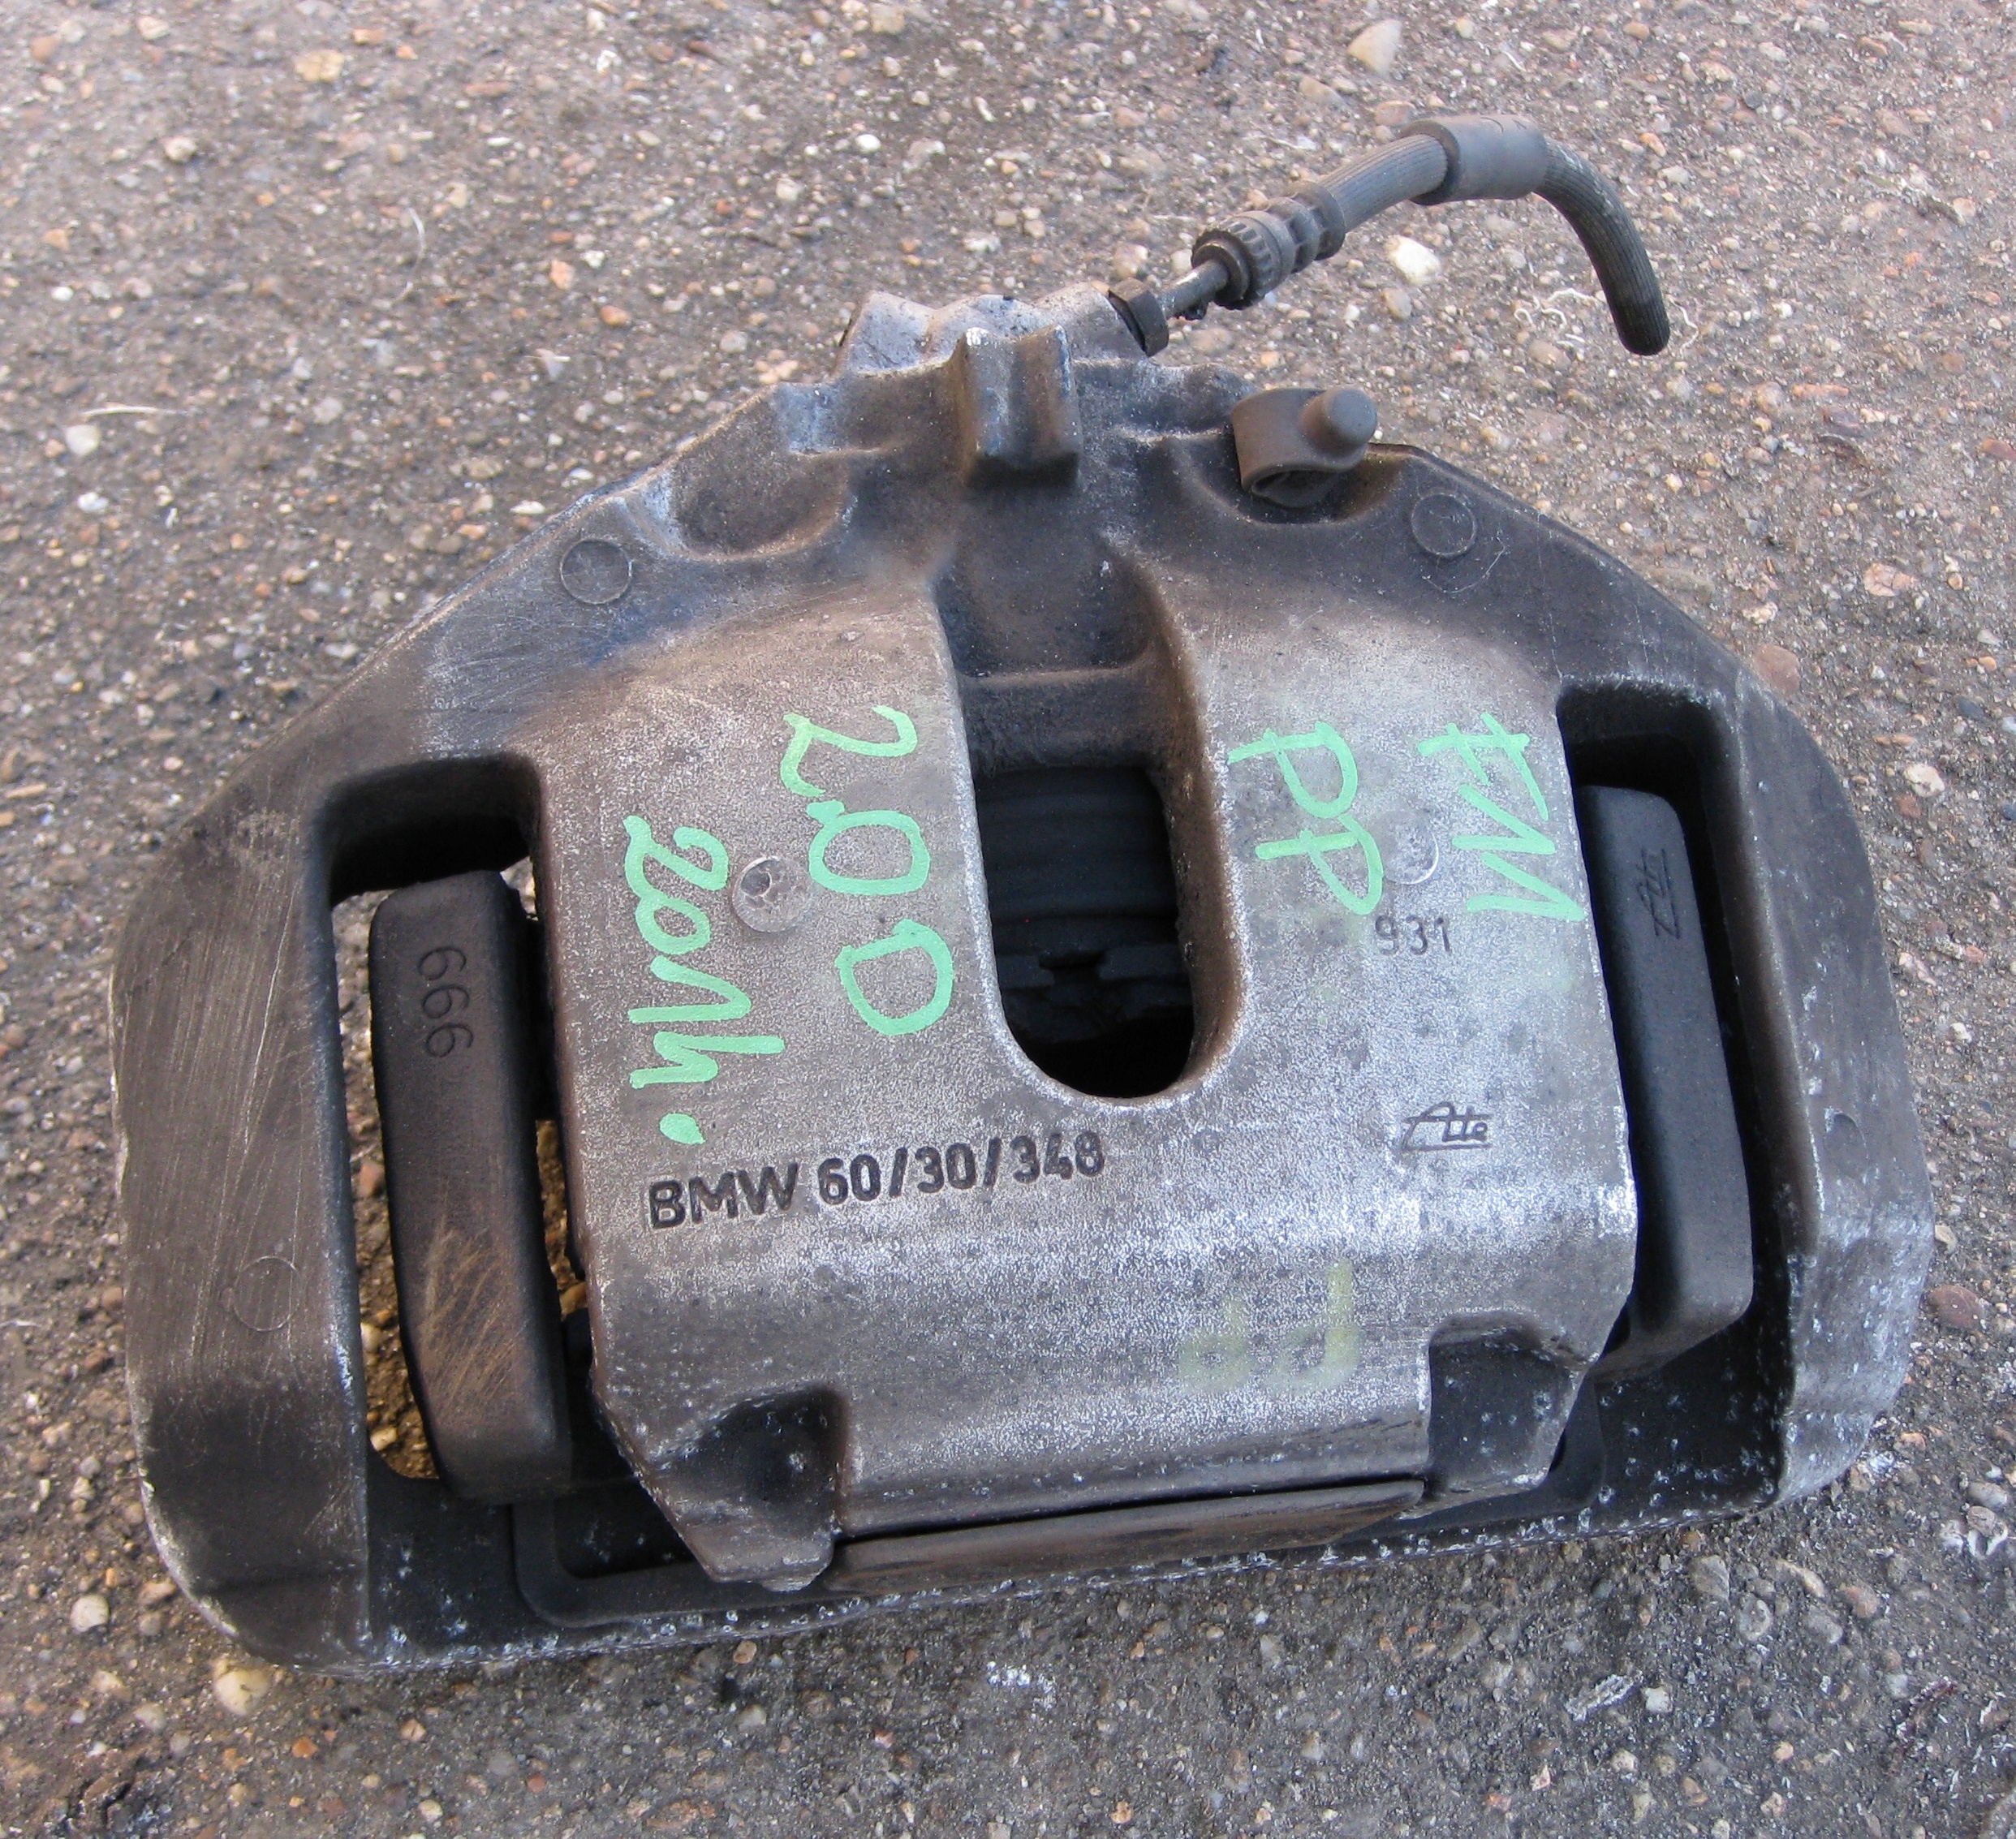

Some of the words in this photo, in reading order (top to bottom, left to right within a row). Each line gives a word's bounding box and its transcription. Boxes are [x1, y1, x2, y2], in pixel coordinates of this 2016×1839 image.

[1227, 721, 1384, 915] PP
[1418, 711, 1585, 922] F11
[1374, 914, 1452, 956] 931
[649, 1161, 799, 1230] BMW
[816, 1131, 1106, 1206] 60/30/348
